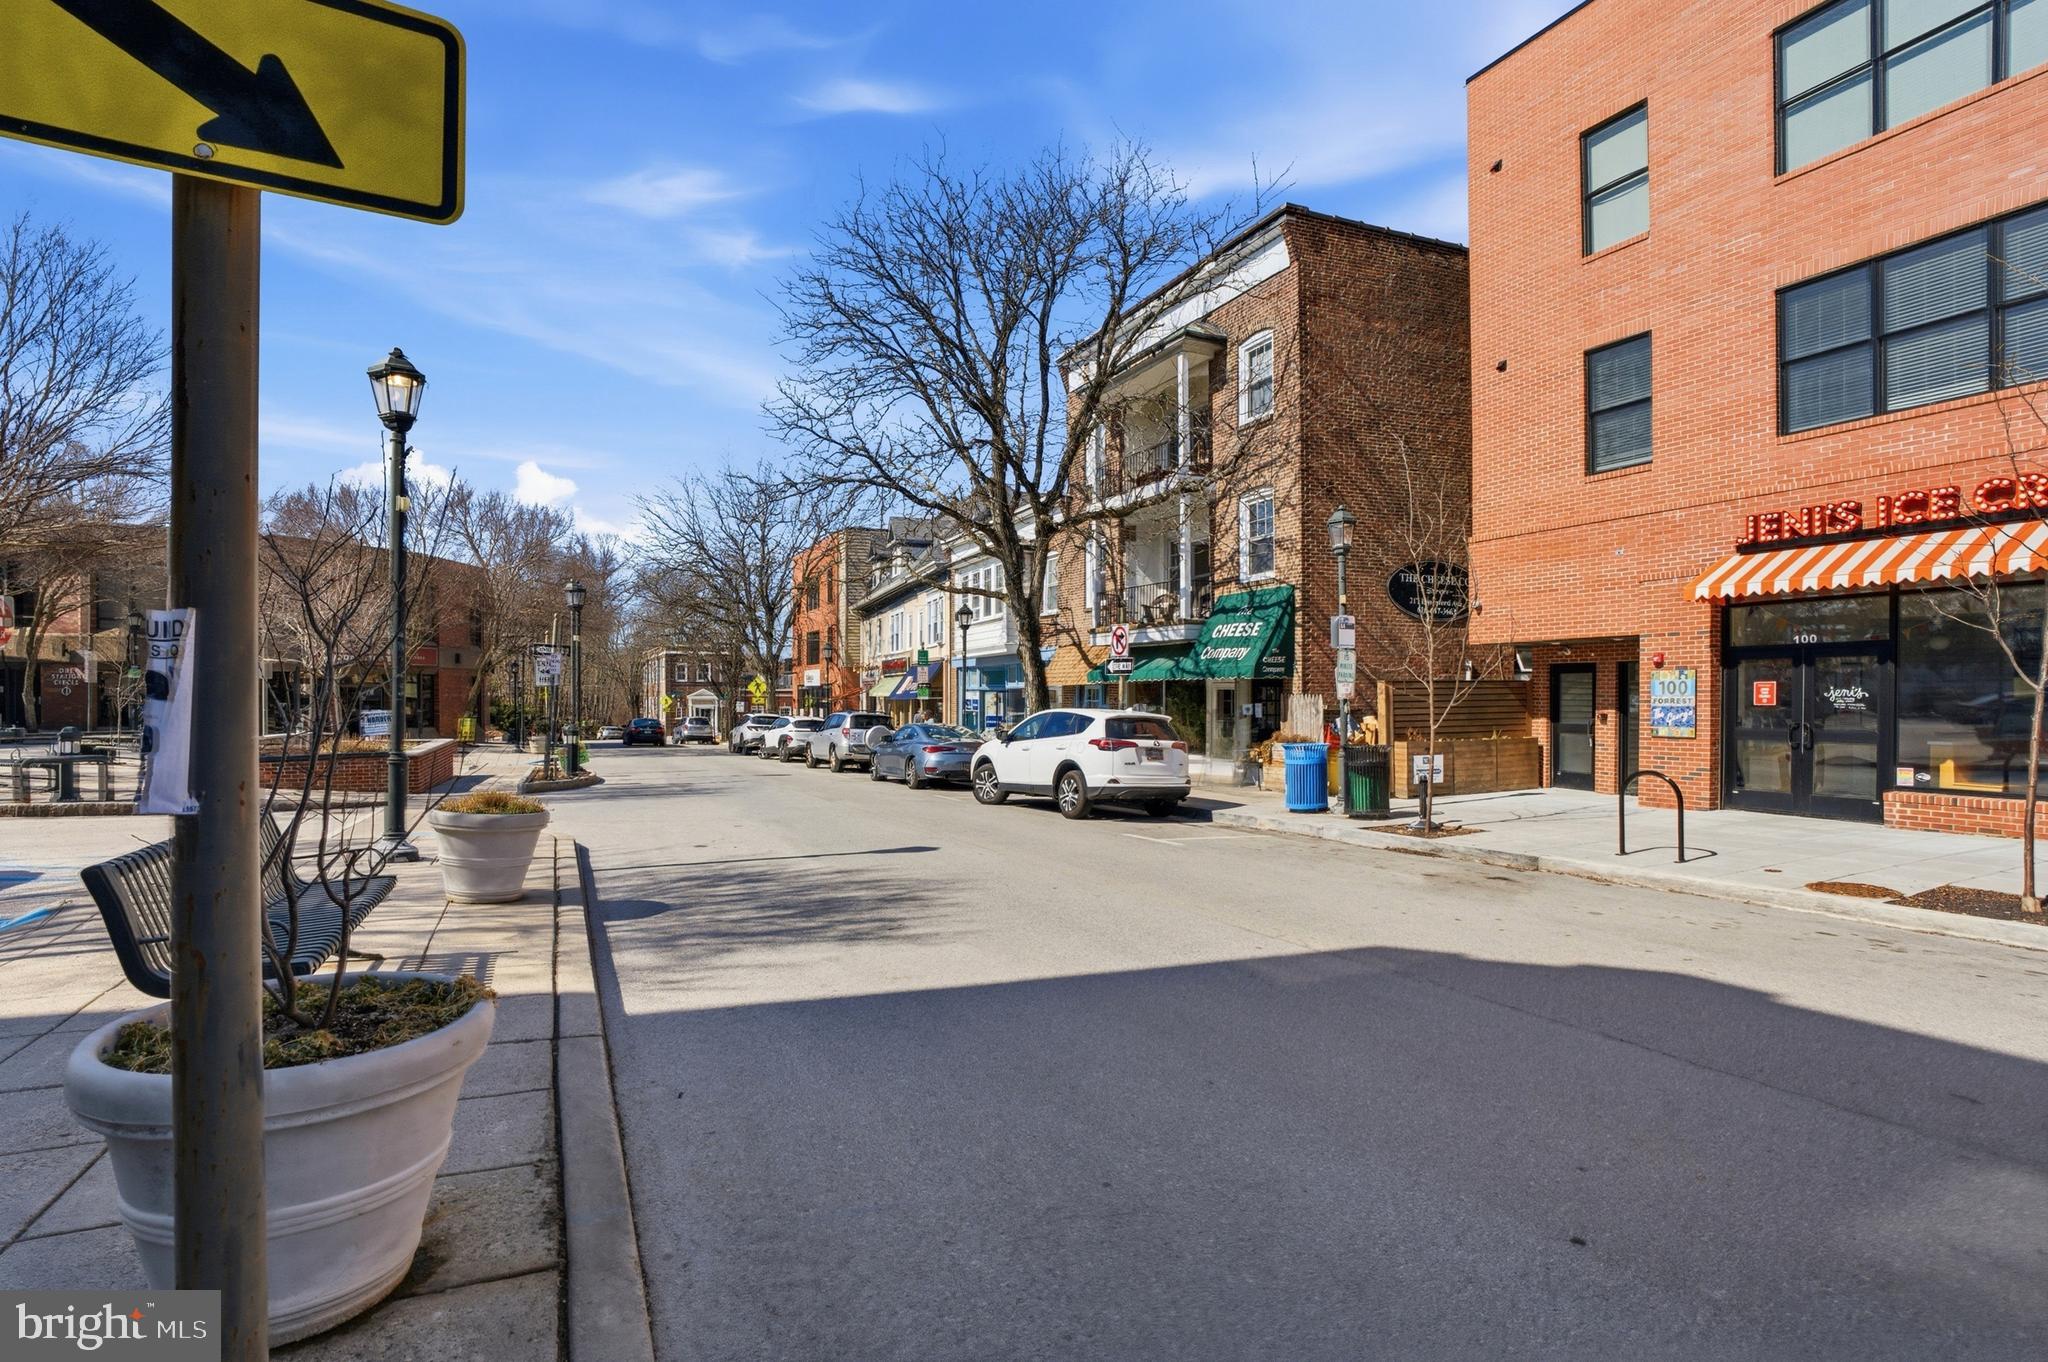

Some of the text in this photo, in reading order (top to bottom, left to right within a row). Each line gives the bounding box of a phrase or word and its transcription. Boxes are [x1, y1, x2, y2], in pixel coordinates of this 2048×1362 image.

[1876, 486, 1961, 528] ICE
[1212, 622, 1263, 638] CHEESE
[1793, 633, 1818, 644] 100
[1201, 646, 1251, 661] Company
[1262, 656, 1287, 664] CHEESE
[1659, 681, 1688, 696] 100
[1824, 686, 1869, 702] jeni's
[1653, 697, 1692, 705] FORREST
